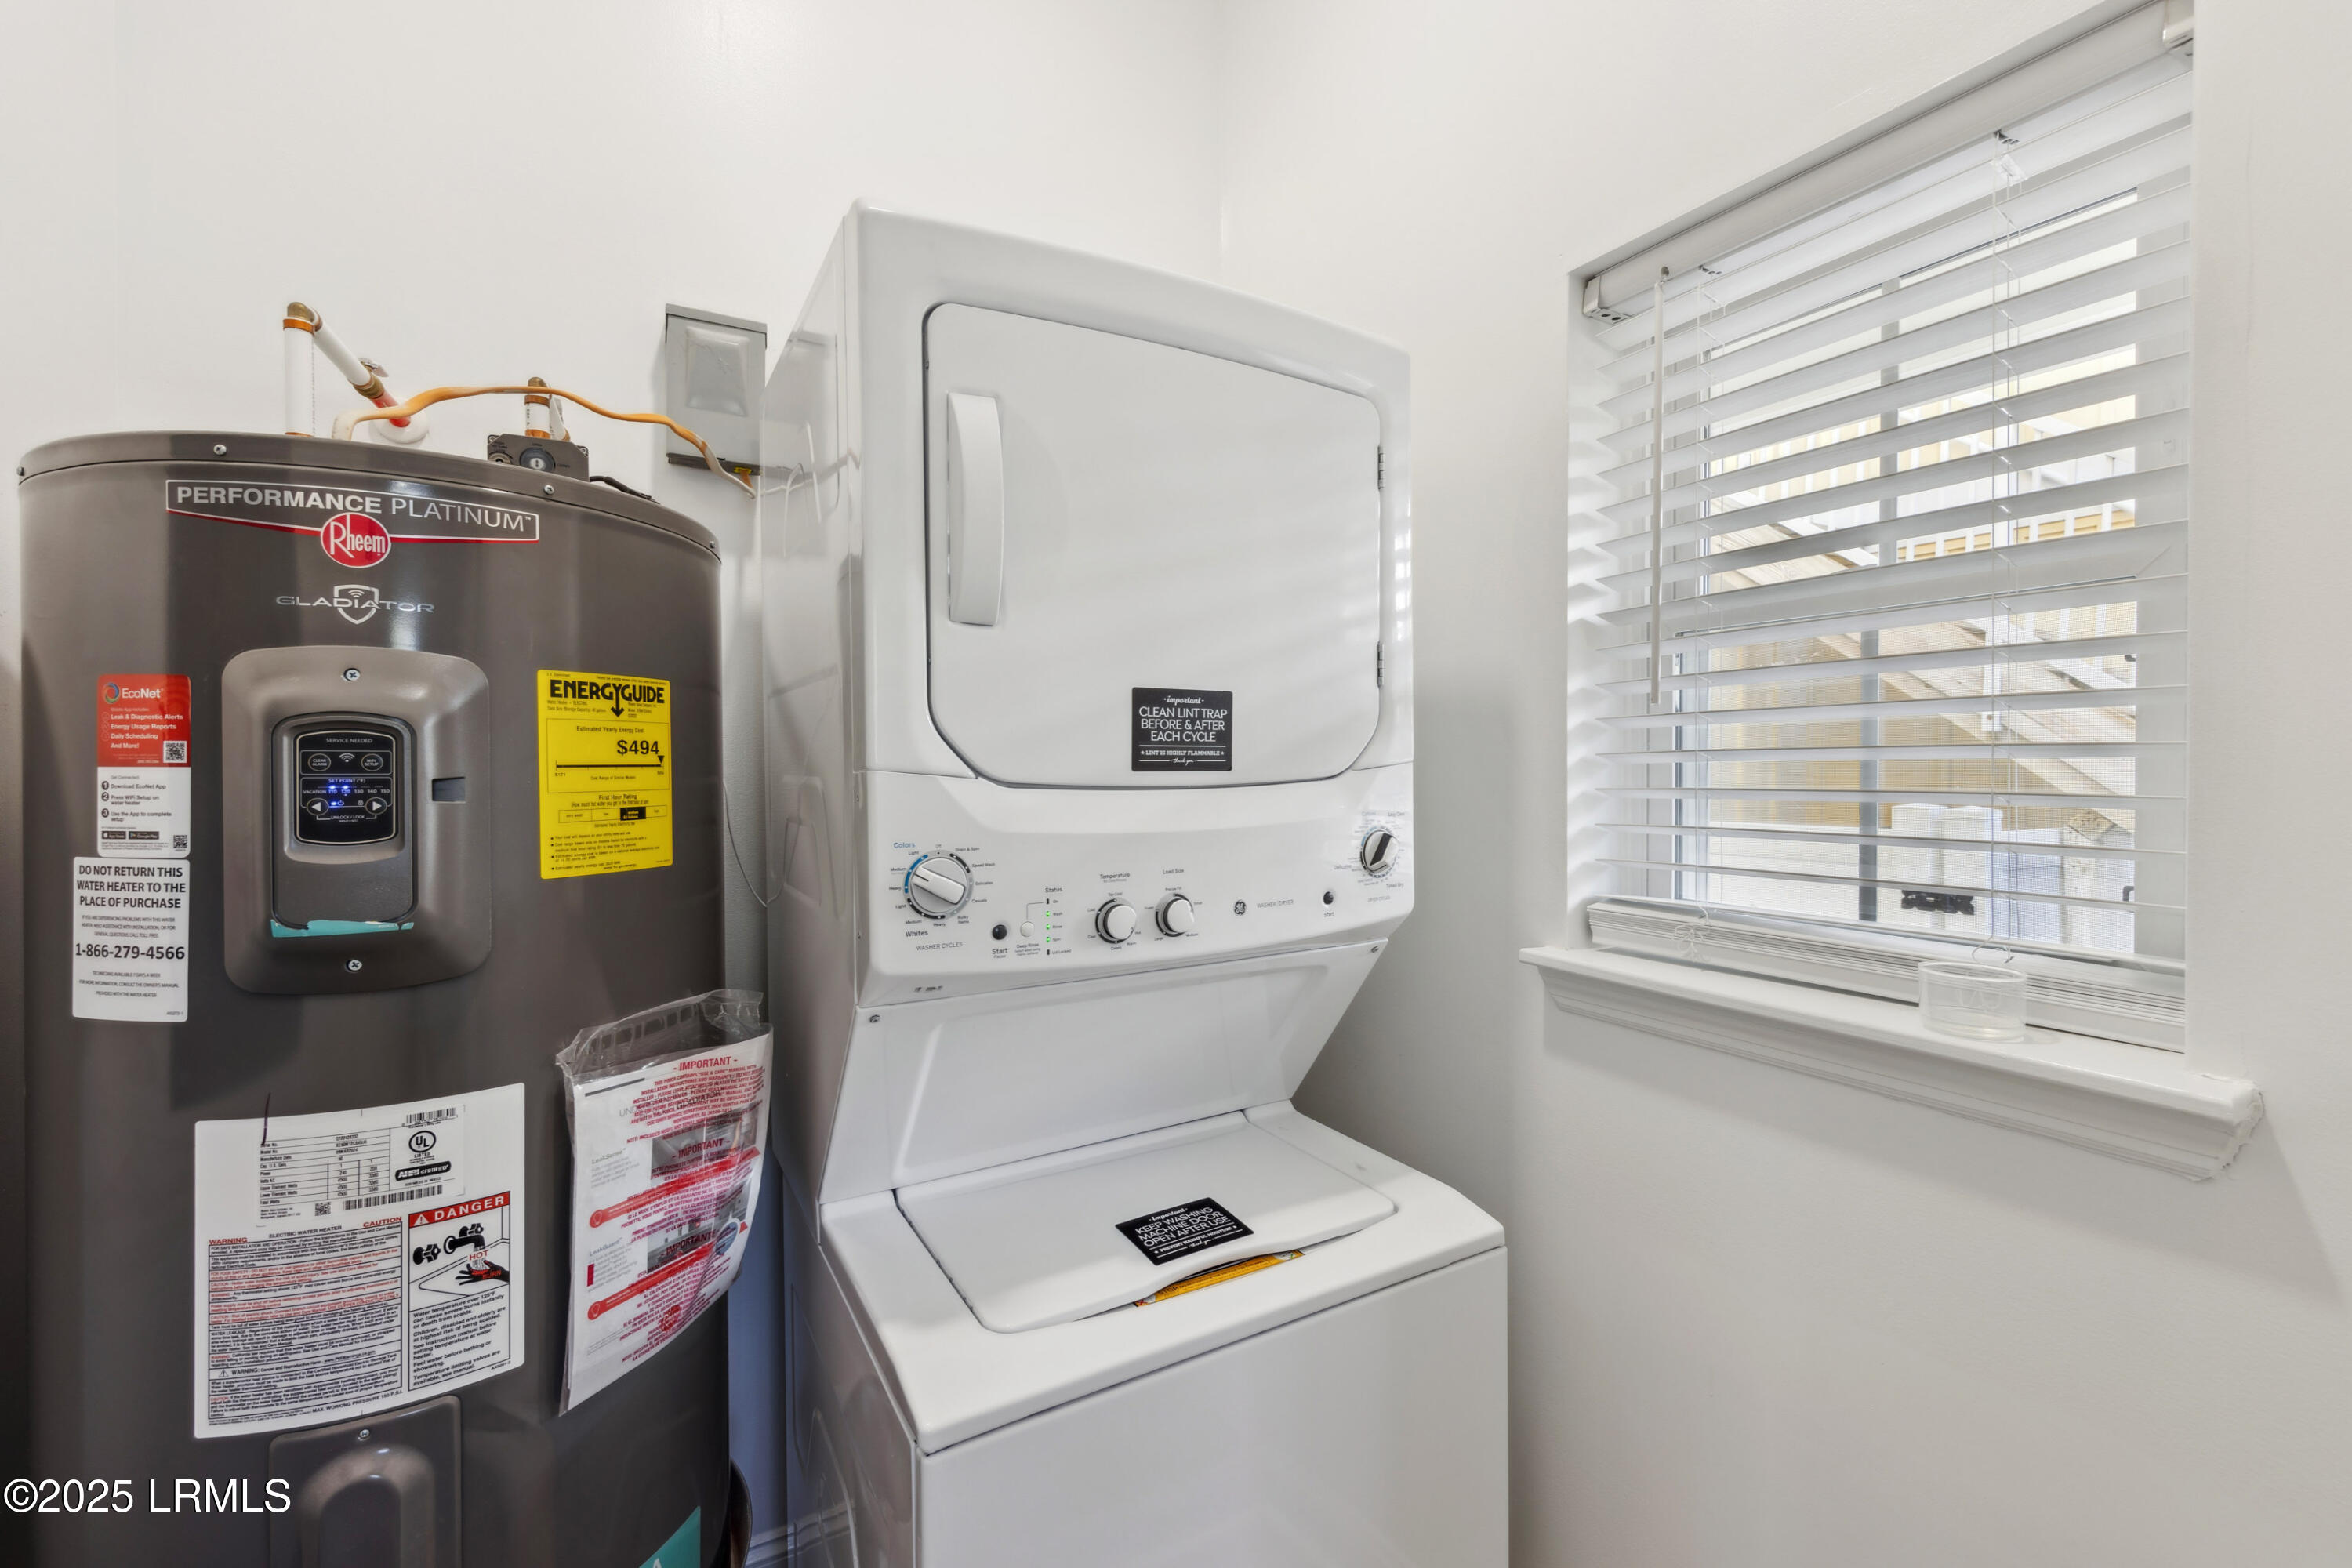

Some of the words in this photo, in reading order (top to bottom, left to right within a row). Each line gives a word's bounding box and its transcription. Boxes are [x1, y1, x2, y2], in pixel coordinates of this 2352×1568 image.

[176, 486, 383, 514] PERFORMANCE
[330, 514, 386, 558] Rheem
[276, 595, 435, 612] GLADIATOR
[122, 688, 161, 699] EcoNet
[550, 679, 665, 704] ENERGYGUIDE
[1139, 706, 1174, 717] CLEAN
[1178, 708, 1200, 718] LINT
[1201, 709, 1227, 719] TRAP
[1142, 719, 1182, 730] BEFORE
[1185, 720, 1192, 730] &
[1194, 720, 1225, 731] AFTER
[1151, 731, 1180, 742] EACH
[1183, 731, 1216, 742] CYCLE
[617, 740, 659, 756] $494
[79, 865, 92, 875] DO
[93, 866, 112, 876] NOT
[114, 866, 155, 877] RETURN
[157, 867, 183, 877] THIS
[78, 880, 105, 891] WATER
[107, 882, 144, 892] HEATER
[147, 883, 161, 892] TO
[164, 883, 186, 892] THE
[80, 896, 106, 906] PLACE
[108, 897, 121, 907] OF
[123, 898, 181, 908] PURCHASE
[75, 943, 185, 960] 1-866-279-4566
[680, 1056, 731, 1071] IMPORTANT
[416, 1135, 430, 1147] UL
[678, 1138, 724, 1159] IMPORTANT
[434, 1196, 505, 1221] DANGER
[363, 1217, 401, 1228] CAUTION
[1135, 1222, 1162, 1235] KEEP
[1162, 1207, 1214, 1225] WASHING
[1138, 1220, 1189, 1241] MACHINE
[1189, 1211, 1223, 1224] DOOR
[297, 1228, 318, 1236] WATER
[1144, 1232, 1177, 1247] OPEN
[1178, 1223, 1210, 1236] AFTER
[1208, 1215, 1231, 1226] USE
[666, 1232, 716, 1254] IMPORTANTE
[1160, 1242, 1183, 1252] PREVENT
[1183, 1234, 1207, 1246] HARMFUL
[1207, 1226, 1232, 1236] MOISTURE
[469, 1250, 489, 1261] HOT
[482, 1269, 503, 1280] BURN
[432, 1300, 466, 1314] temperature
[481, 1294, 504, 1305] instantly
[441, 1319, 465, 1330] disabled
[477, 1309, 495, 1319] elderly
[420, 1330, 442, 1341] highest
[463, 1321, 477, 1330] being
[326, 1401, 351, 1411] WORKING
[353, 1396, 379, 1406] PRESSURE
